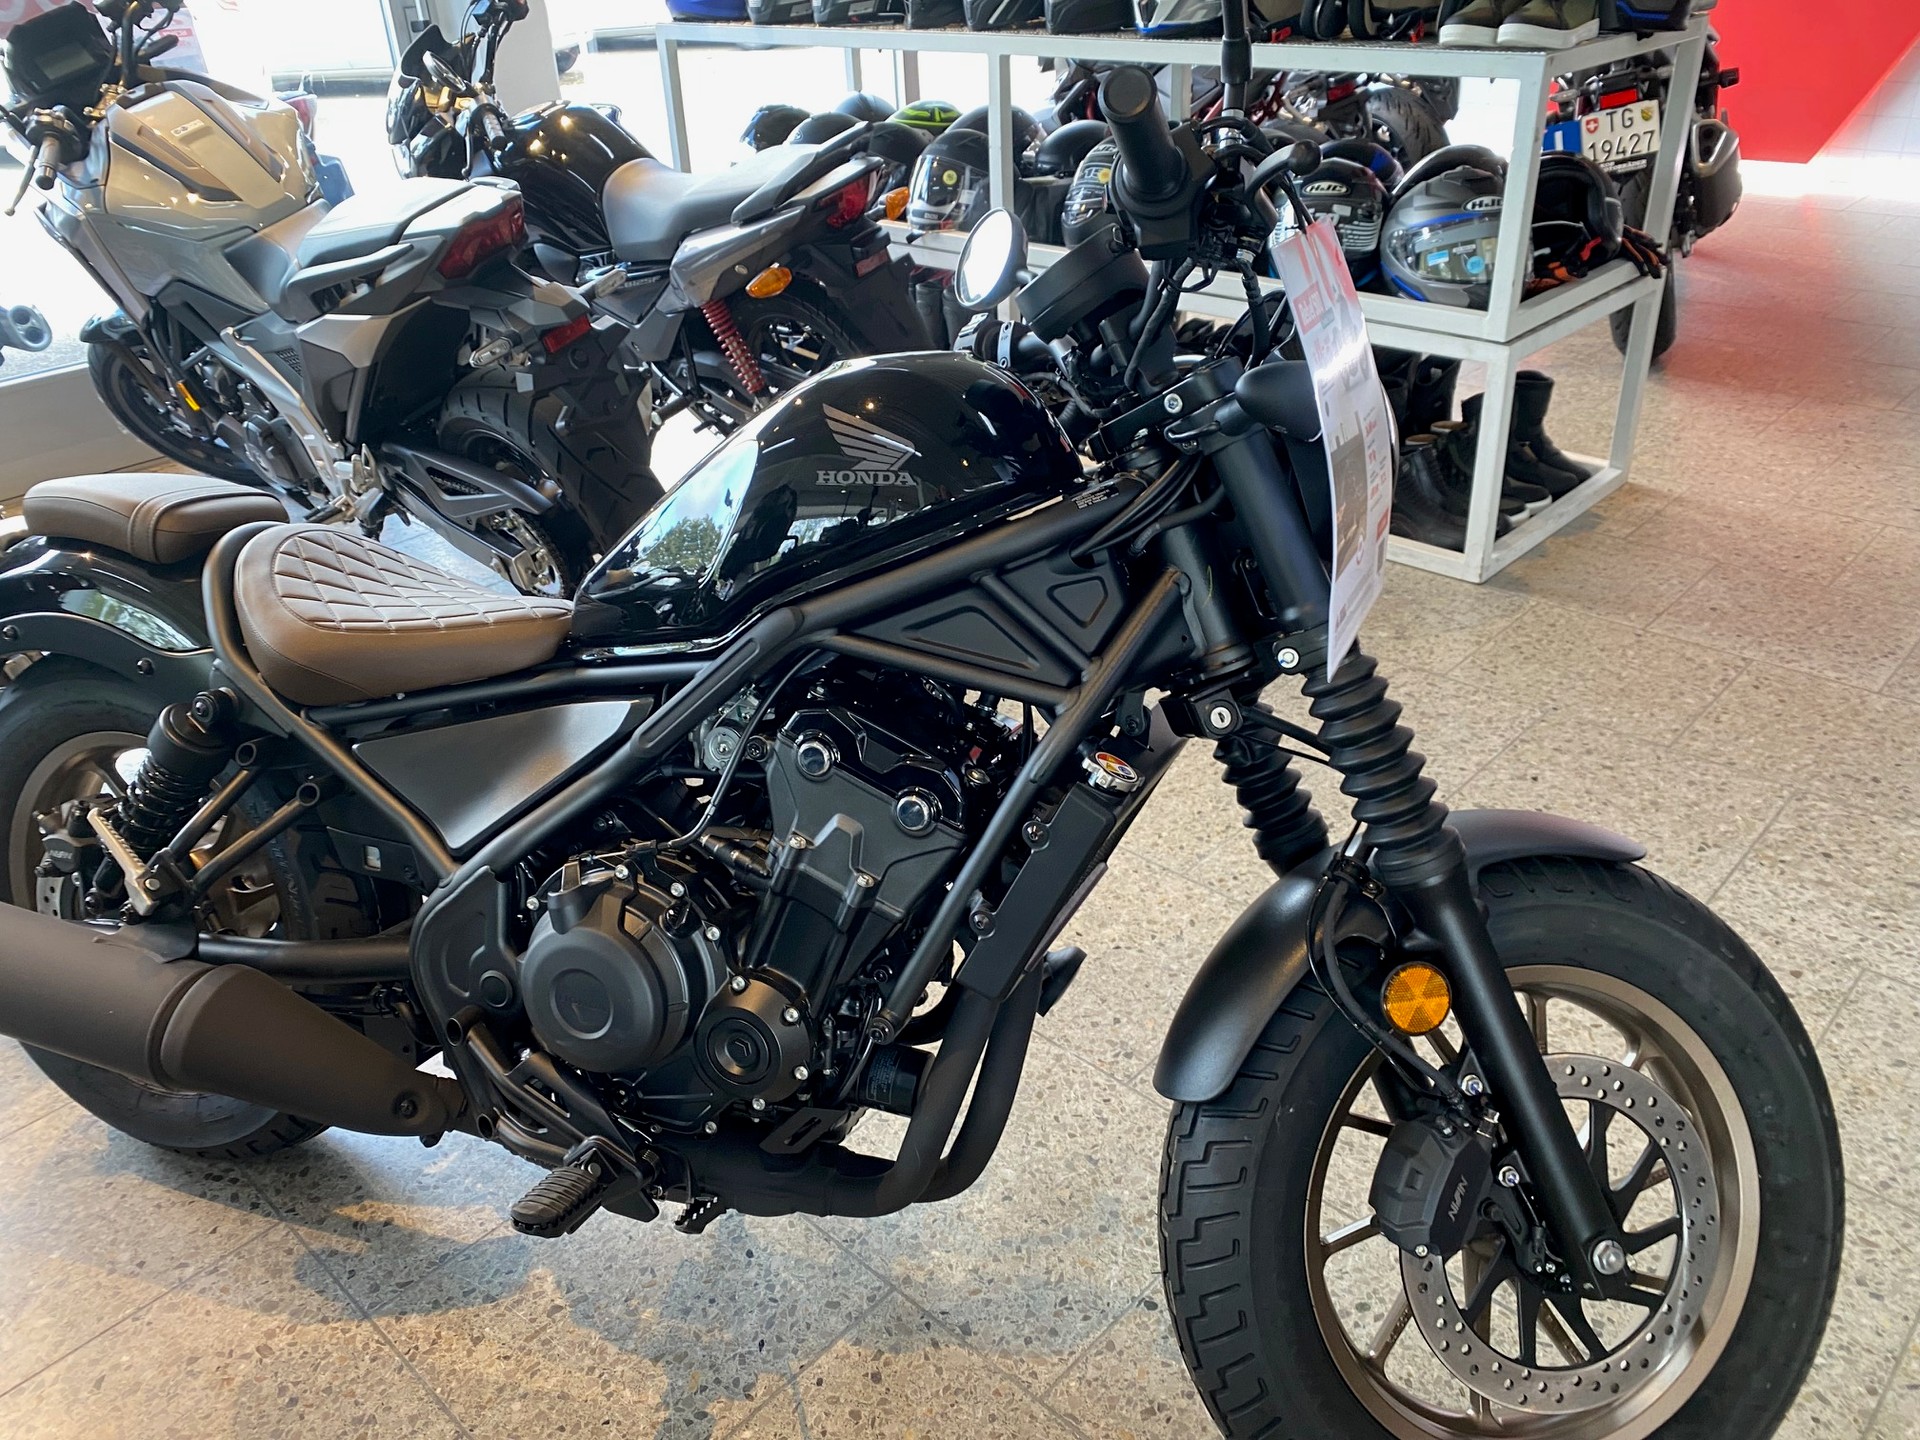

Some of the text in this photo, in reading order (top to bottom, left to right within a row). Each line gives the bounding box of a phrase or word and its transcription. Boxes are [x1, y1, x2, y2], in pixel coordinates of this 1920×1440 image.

[1606, 108, 1634, 132] TG
[1588, 130, 1655, 161] 19427
[1307, 183, 1346, 193] HJC
[815, 470, 917, 486] HONDA
